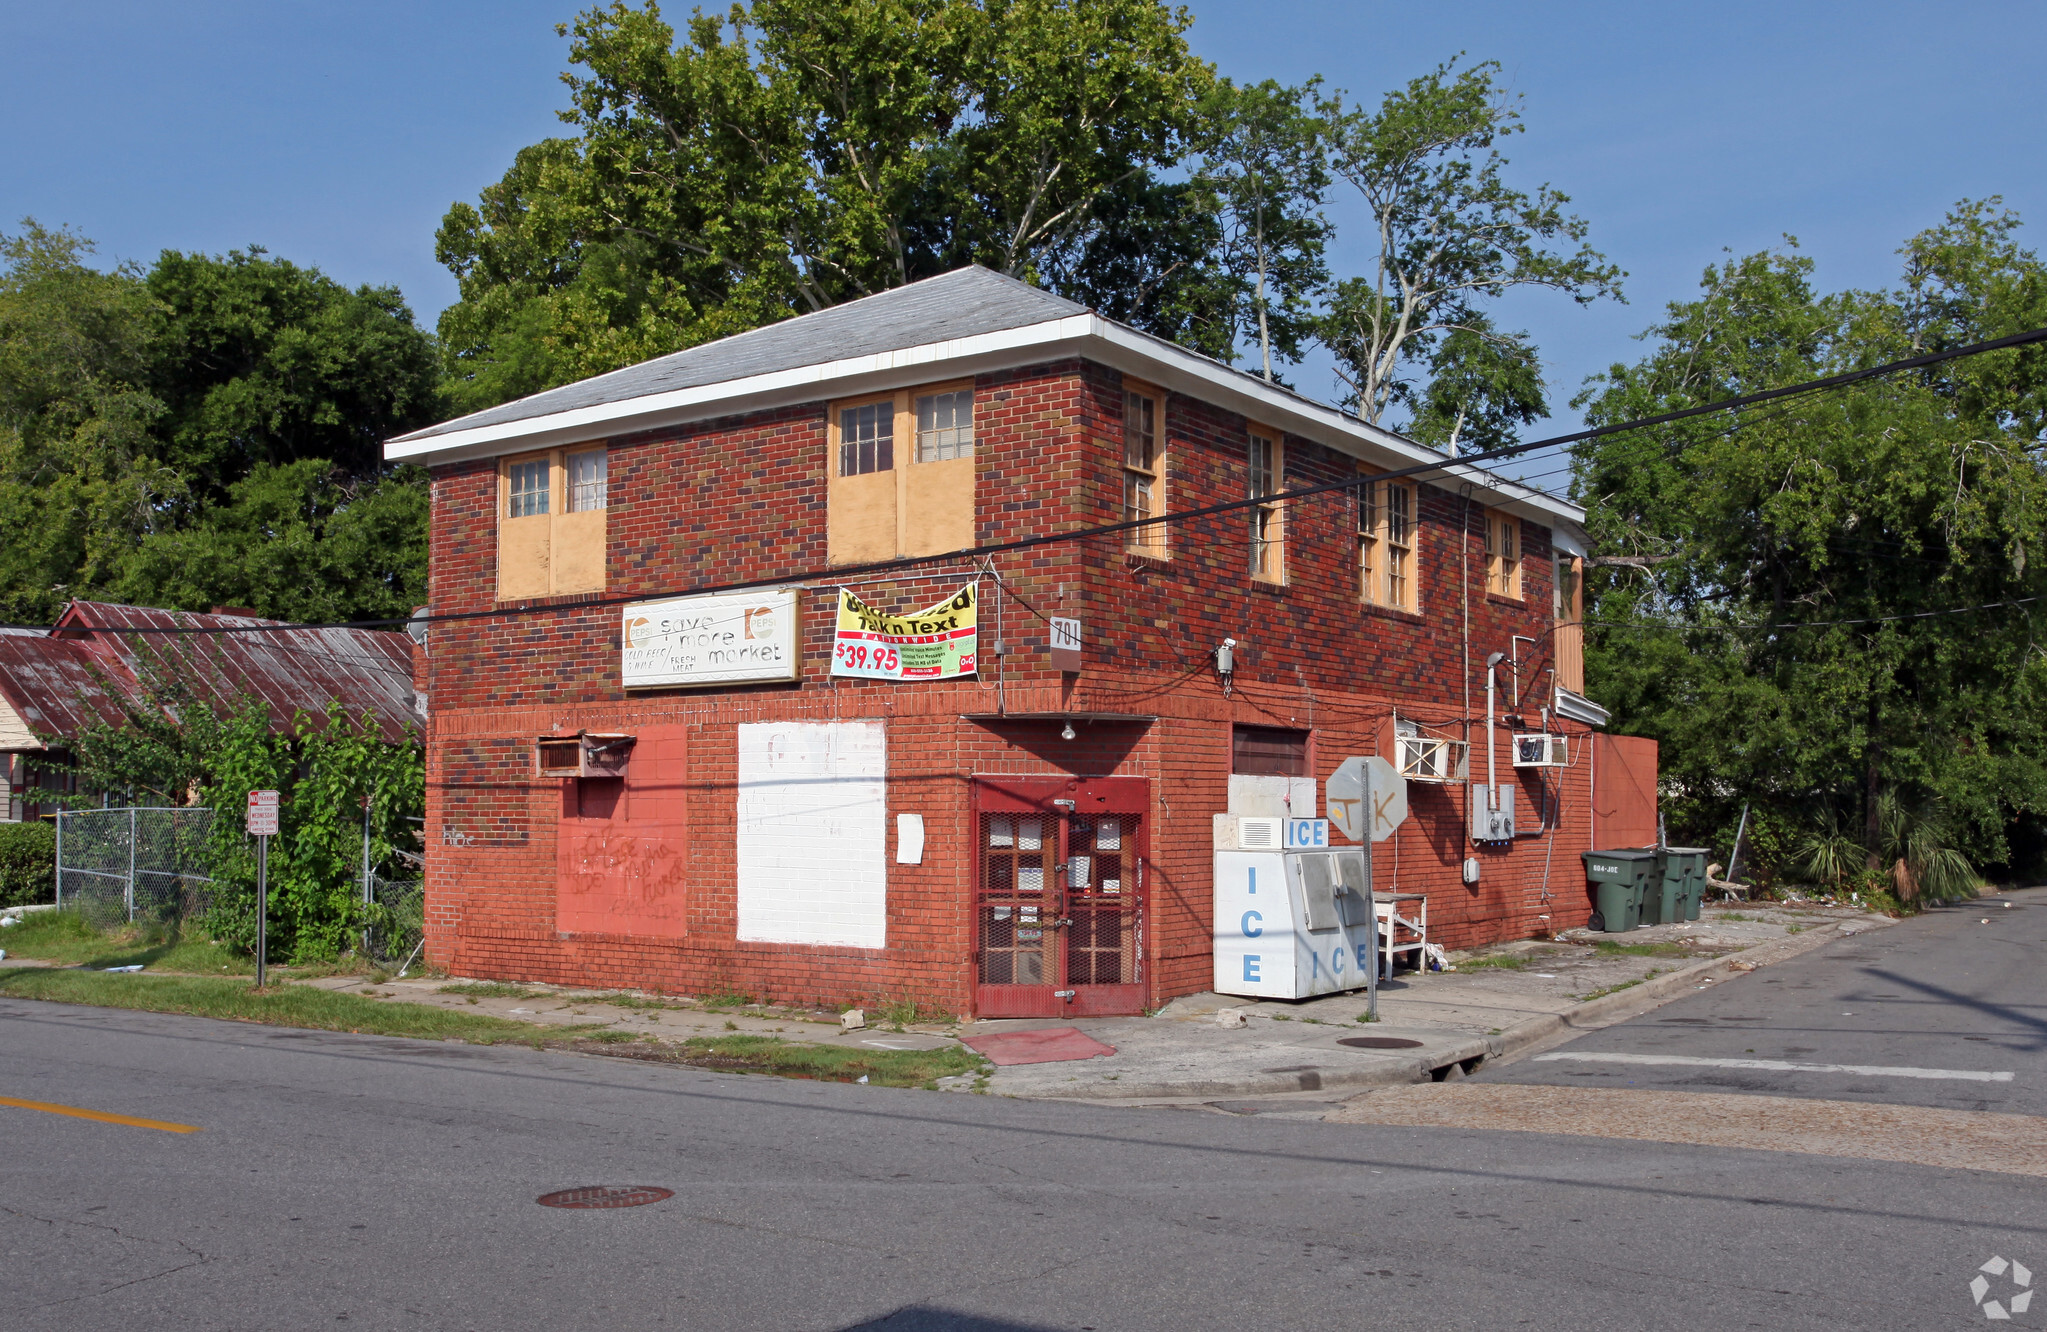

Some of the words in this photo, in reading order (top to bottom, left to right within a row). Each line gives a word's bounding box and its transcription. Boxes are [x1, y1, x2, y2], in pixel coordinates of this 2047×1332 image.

[630, 627, 653, 637] PEPSI
[750, 618, 777, 628] PEPSI
[907, 616, 958, 635] Text
[679, 632, 735, 649] more
[861, 632, 952, 645] NATIONWIDE
[1055, 621, 1078, 646] 701
[670, 655, 697, 665] FRESH
[708, 643, 782, 664] market
[836, 641, 898, 671] $39.95
[672, 664, 694, 673] MEAT
[250, 794, 258, 803] NO
[1288, 820, 1324, 846] ICE
[1241, 866, 1264, 983] ICE
[1312, 943, 1367, 979] ICE
